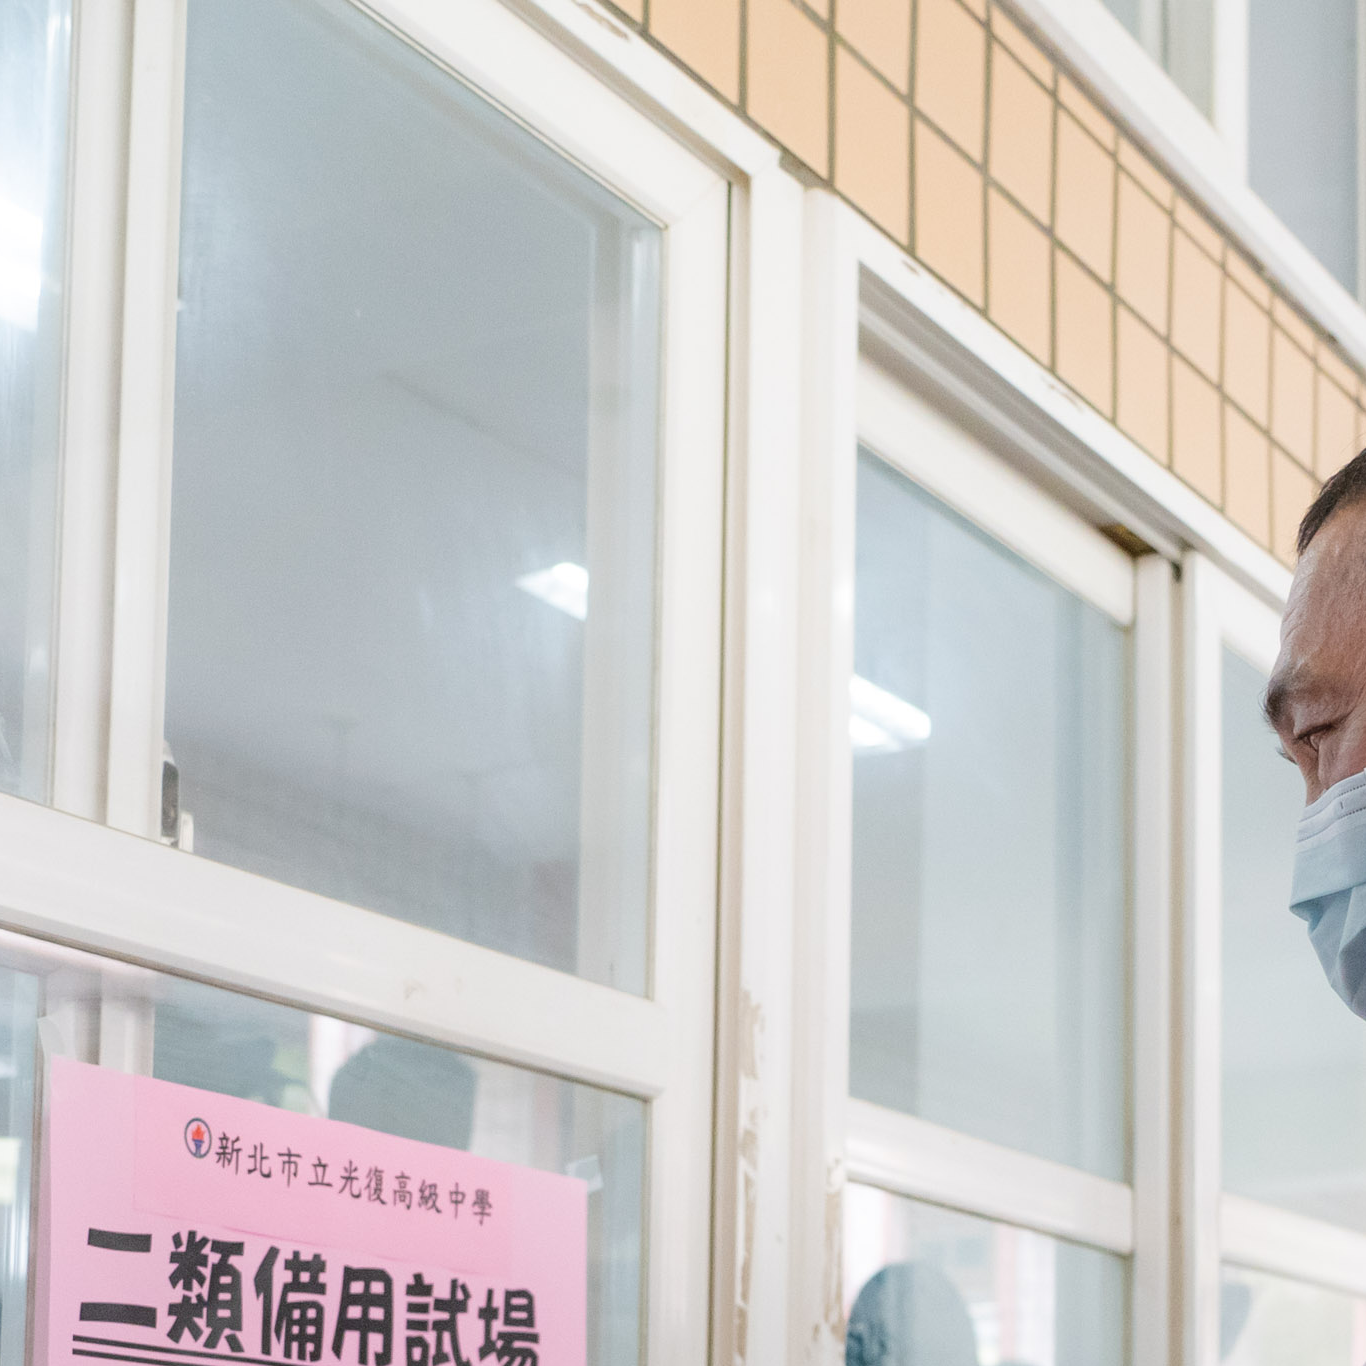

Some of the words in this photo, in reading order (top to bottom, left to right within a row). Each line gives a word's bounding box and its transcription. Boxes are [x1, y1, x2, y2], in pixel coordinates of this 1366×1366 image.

[215, 1131, 493, 1226] 新北市立光復高級中學
